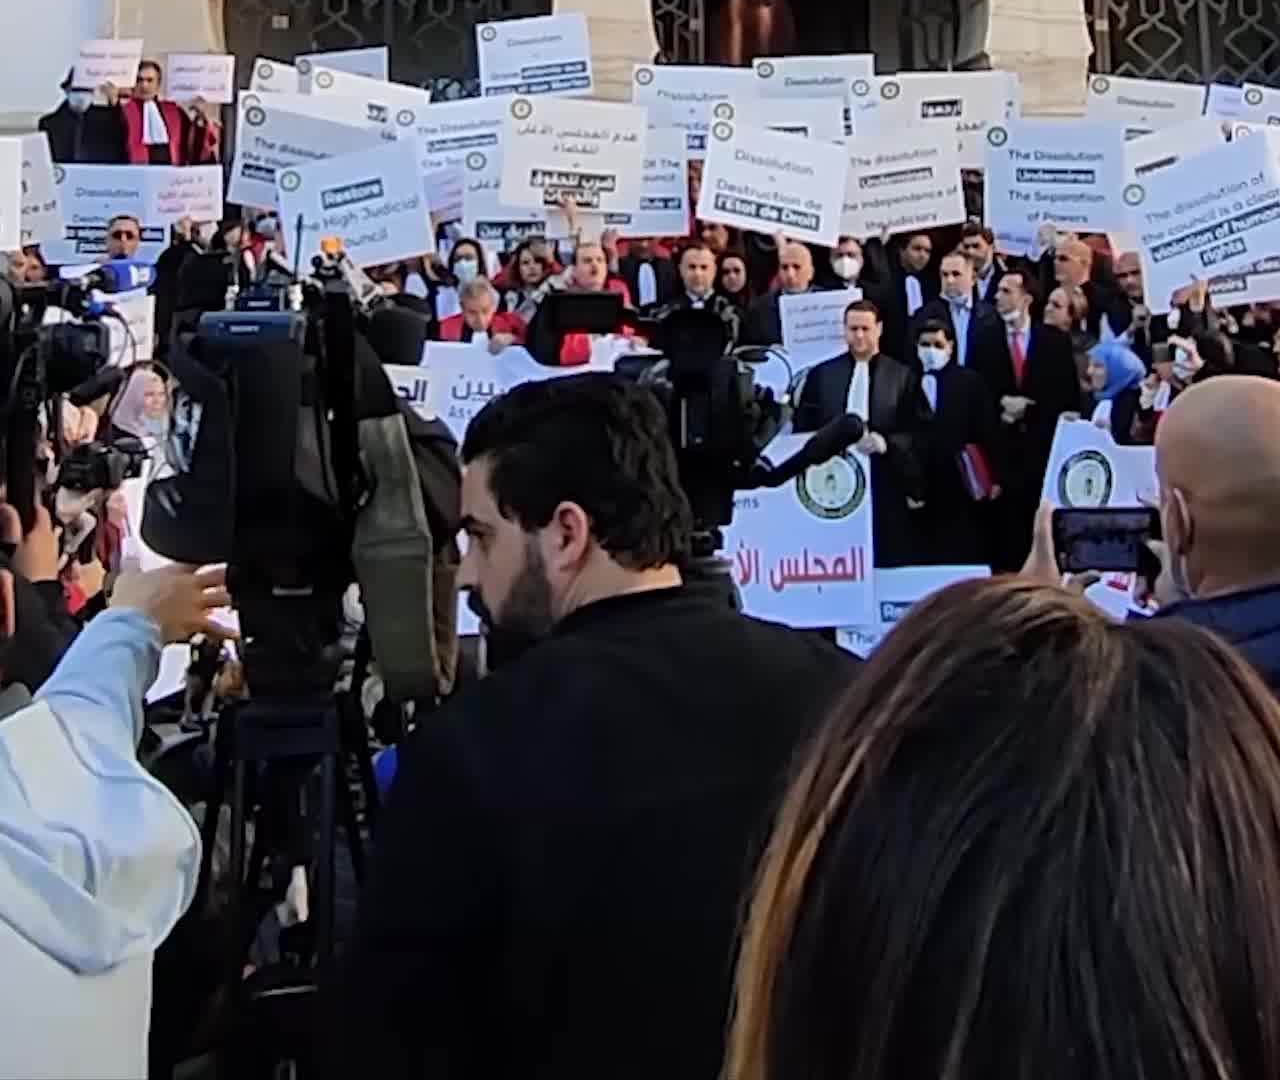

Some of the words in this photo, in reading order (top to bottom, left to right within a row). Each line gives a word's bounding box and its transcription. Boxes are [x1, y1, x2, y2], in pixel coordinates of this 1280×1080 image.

[734, 149, 814, 176] Dissolution
[1007, 149, 1030, 161] The
[1033, 149, 1105, 161] Dissolution
[715, 178, 801, 206] Destruction
[804, 199, 822, 211] de
[1007, 189, 1030, 201] The
[1033, 189, 1106, 204] Separation
[1174, 180, 1249, 220] dissolution
[1251, 171, 1265, 187] of
[1027, 211, 1040, 222] of
[1043, 211, 1089, 223] Powers
[1168, 209, 1218, 236] council
[1232, 199, 1244, 211] a
[1247, 188, 1280, 208] clear
[770, 546, 865, 594] المجلس
